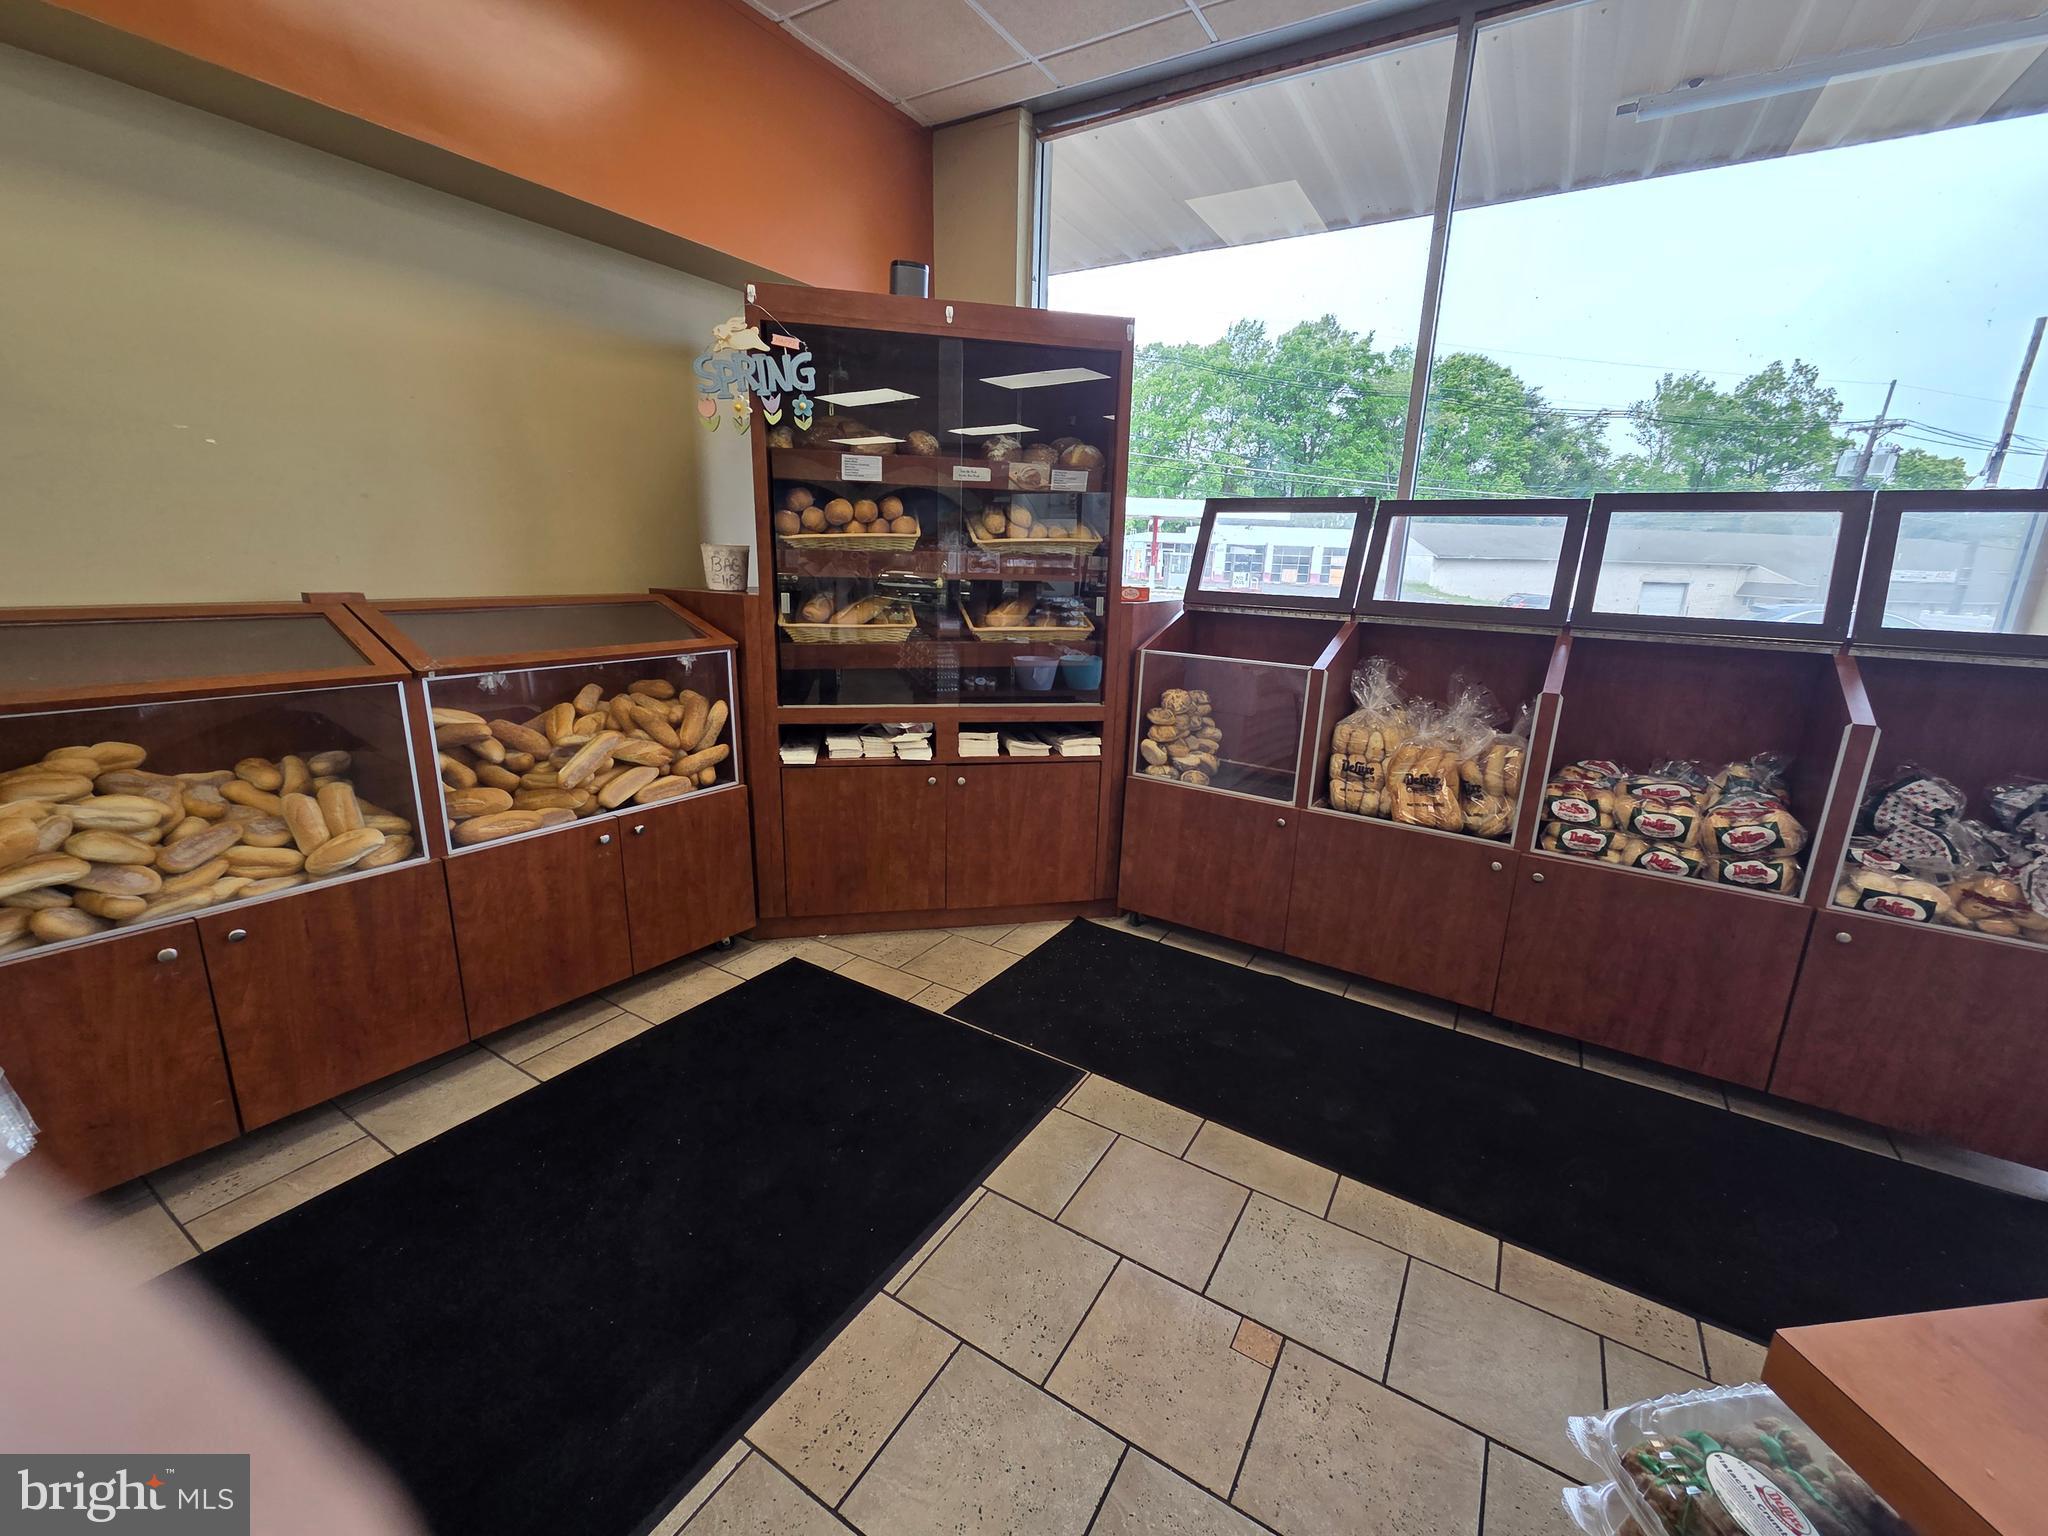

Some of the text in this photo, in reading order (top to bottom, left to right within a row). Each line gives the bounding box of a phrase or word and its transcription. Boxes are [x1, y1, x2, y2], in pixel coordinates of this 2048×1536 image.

[693, 351, 816, 400] SPRING
[1342, 759, 1375, 776] DeLuxe
[1714, 1454, 1756, 1501] Pistachio
[1768, 1492, 1804, 1530] DeLuxe
